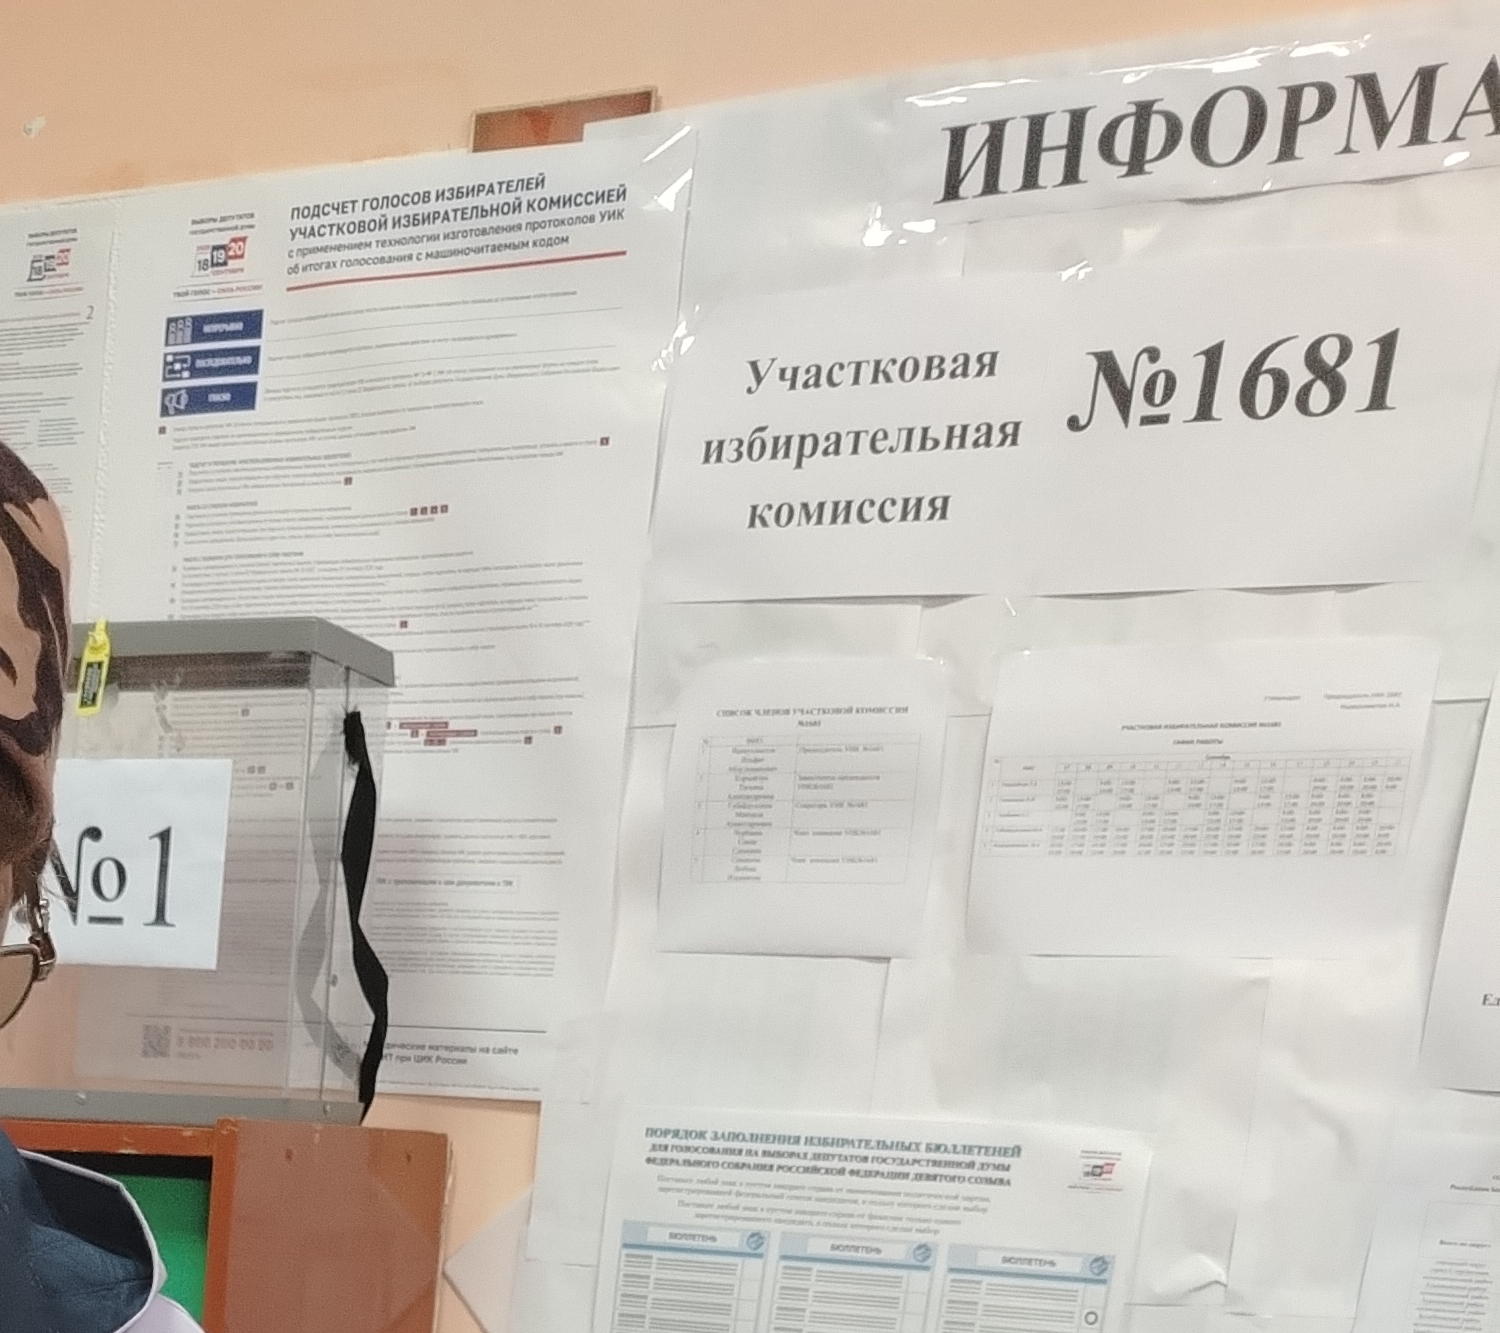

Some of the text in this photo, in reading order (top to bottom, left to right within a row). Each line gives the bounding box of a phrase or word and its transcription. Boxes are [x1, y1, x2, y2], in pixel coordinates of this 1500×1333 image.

[290, 184, 627, 241] УЧАСТКОВОЙ ИЗБИРАТЕЛЬНОЙ КОМИССИЕЙ
[291, 173, 546, 221] ПОДСЧЕТ ГОЛОСОВ ИЗБИРАТЕЛЕЙ
[228, 241, 244, 256] 20
[288, 209, 625, 260] с применением технологии изготовления протоколов УИК
[197, 259, 209, 271] 18
[213, 249, 226, 264] 19
[287, 234, 570, 276] об итогах голосования с машиночитаемым кодом
[85, 305, 95, 321] 2
[745, 348, 1001, 396] Участковая
[1066, 326, 1402, 435] №1681
[702, 416, 1024, 473] избирательная
[745, 490, 952, 533] комиссия
[49, 826, 176, 928] №1
[645, 1127, 1022, 1158] ПОРЯДОК ЗАПОЛНЕНИЯ ИЗБИРАТЕЛЬНЫХ БЮЛЛЕТЕНЕЙ
[650, 1143, 1011, 1172] ДЛЯ ГОЛОСОВАНИЯ НА ВЫБОРАХ ДЕПУТАТОВ ГОСУДАРСТВЕННОЙ ДУМЫ
[645, 1156, 720, 1169] ФЕДЕРАЛЬНОГО
[721, 1160, 774, 1172] СОБРАНИЯ
[776, 1163, 846, 1176] РОССИЙСКОЙ
[668, 1231, 717, 1243] БЮЛЛЕТЕНЬ
[830, 1243, 882, 1255] БЮЛЛЕТЕНЬ
[1001, 1255, 1056, 1268] БЮЛЛЕТЕНЬ
